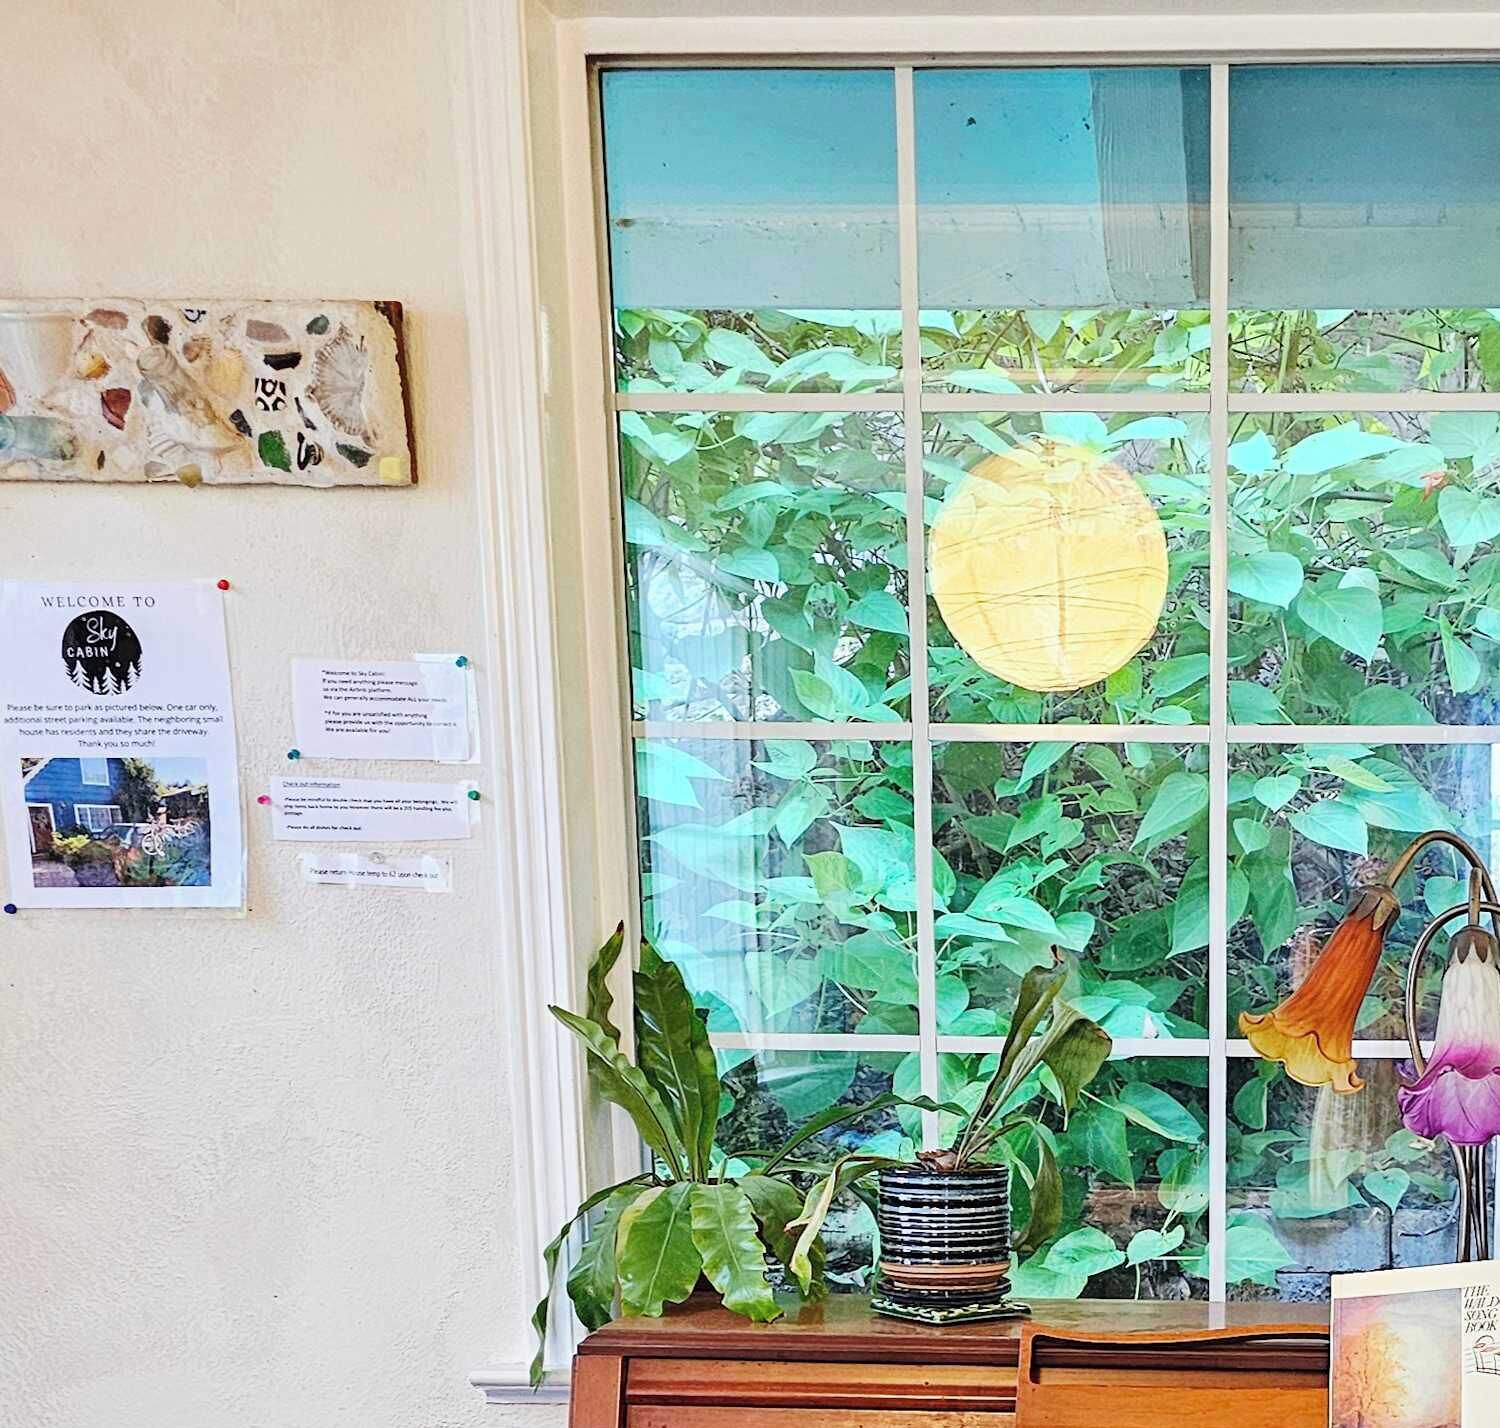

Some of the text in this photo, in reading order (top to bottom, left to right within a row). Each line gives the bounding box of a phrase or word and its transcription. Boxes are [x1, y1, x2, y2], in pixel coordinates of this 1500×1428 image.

[41, 596, 156, 607] WELCOME TO
[86, 616, 118, 650] Sky
[66, 647, 109, 658] CABIN
[75, 704, 92, 712] park
[105, 704, 137, 712] pictured
[69, 716, 98, 724] parking
[154, 716, 201, 724] neighboring
[115, 729, 132, 737] they
[104, 741, 118, 749] you
[1464, 1285, 1491, 1297] THE
[1464, 1308, 1498, 1320] SONG
[1465, 1320, 1499, 1333] BOOK
